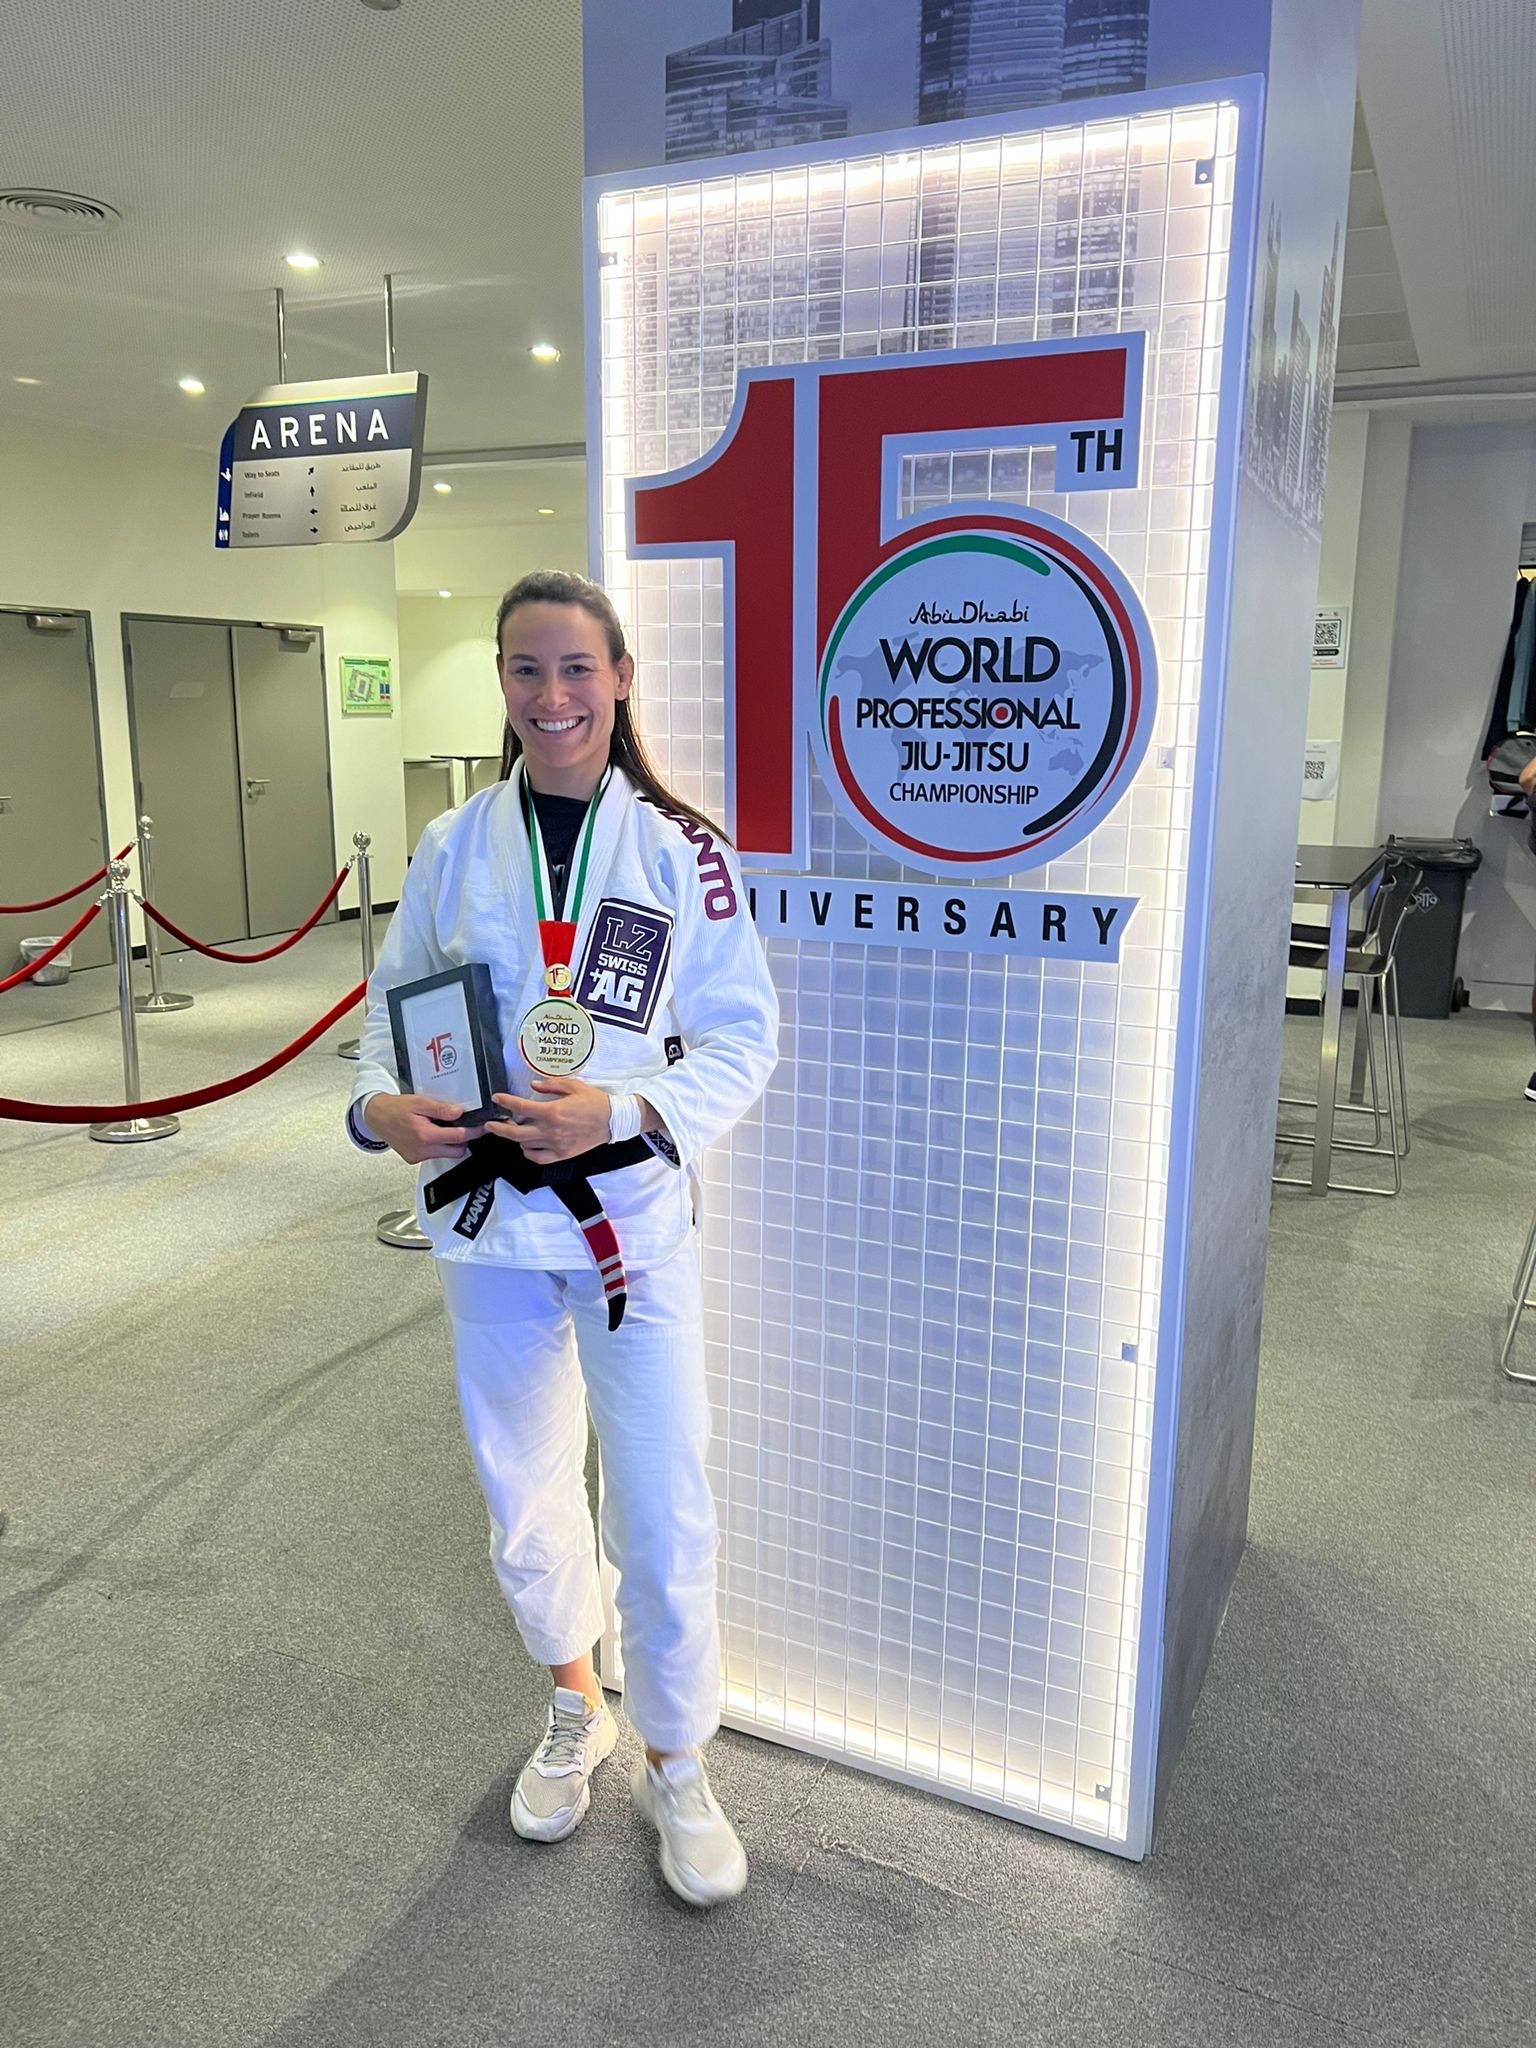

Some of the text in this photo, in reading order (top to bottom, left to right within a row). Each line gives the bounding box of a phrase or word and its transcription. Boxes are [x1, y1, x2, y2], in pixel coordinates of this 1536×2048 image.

[251, 408, 389, 450] ARENA
[635, 348, 1141, 862] 15 TH
[878, 636, 1061, 684] WORLD
[856, 697, 1081, 730] PROFESSIONAL
[901, 741, 1030, 773] JIU-JITSU
[889, 782, 1040, 806] CHAMPIONSHIP
[601, 916, 658, 962] LZ
[597, 953, 648, 977] SWISS
[535, 1022, 580, 1035] WORLD
[539, 1035, 574, 1046] MASTERS
[540, 1047, 572, 1056] JIU-JITSU
